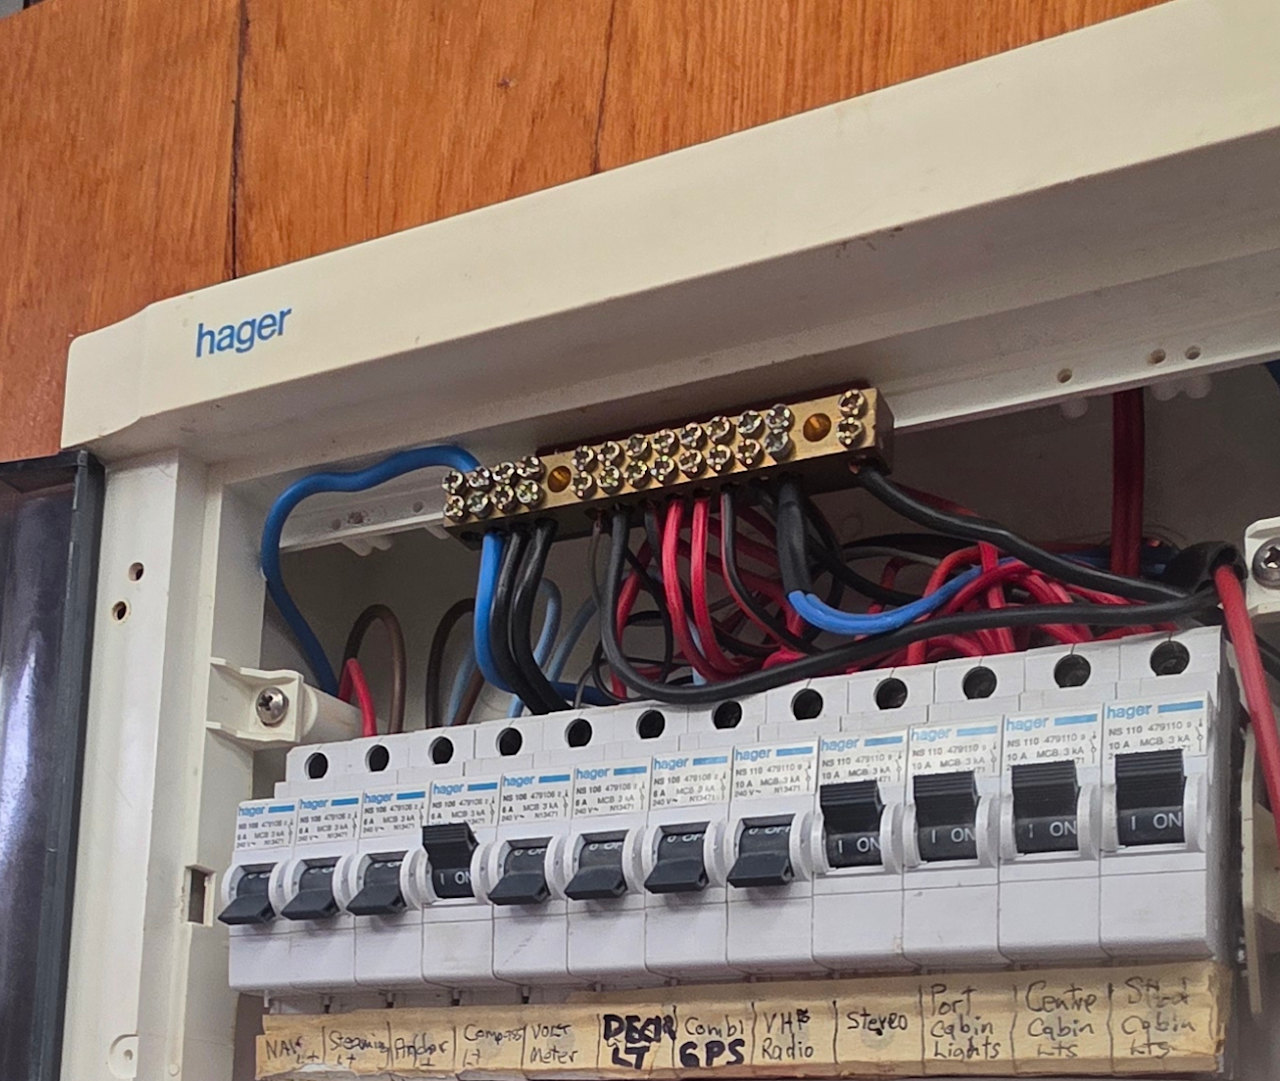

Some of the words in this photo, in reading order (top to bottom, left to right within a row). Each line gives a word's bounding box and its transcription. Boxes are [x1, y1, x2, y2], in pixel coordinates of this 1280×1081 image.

[196, 308, 292, 358] hager
[1107, 704, 1152, 719] hager
[1007, 716, 1049, 732] hager
[1109, 728, 1122, 736] NS
[1126, 726, 1142, 735] 110
[1148, 722, 1182, 733] 479110
[912, 728, 952, 742] hager
[1007, 739, 1021, 748] NS
[1024, 737, 1039, 746] 110
[1108, 741, 1120, 750] 10
[1140, 737, 1163, 747] MCB
[1169, 735, 1175, 744] 3
[1178, 734, 1190, 744] kA
[821, 736, 860, 752] hager
[735, 746, 772, 760] hager
[1008, 753, 1017, 762] 10
[654, 756, 689, 771] hager
[503, 775, 535, 787] hager
[576, 767, 610, 780] hager
[433, 783, 464, 795] hager
[300, 798, 329, 809] hager
[364, 792, 393, 804] hager
[239, 804, 265, 816] hager
[1049, 821, 1077, 836] ON
[1131, 816, 1136, 830] I
[1152, 812, 1182, 829] ON
[931, 830, 935, 843] I
[930, 983, 978, 1016] Port
[1025, 980, 1097, 1014] Centre
[846, 1009, 908, 1036] Stereo
[931, 1016, 993, 1040] Cabin
[1027, 1016, 1095, 1041] Cabin
[1121, 1012, 1196, 1035] Cabin
[679, 1039, 745, 1068] GPS
[762, 1034, 814, 1061] Radio
[934, 1036, 1001, 1059] Lights
[612, 1046, 650, 1070] LT
